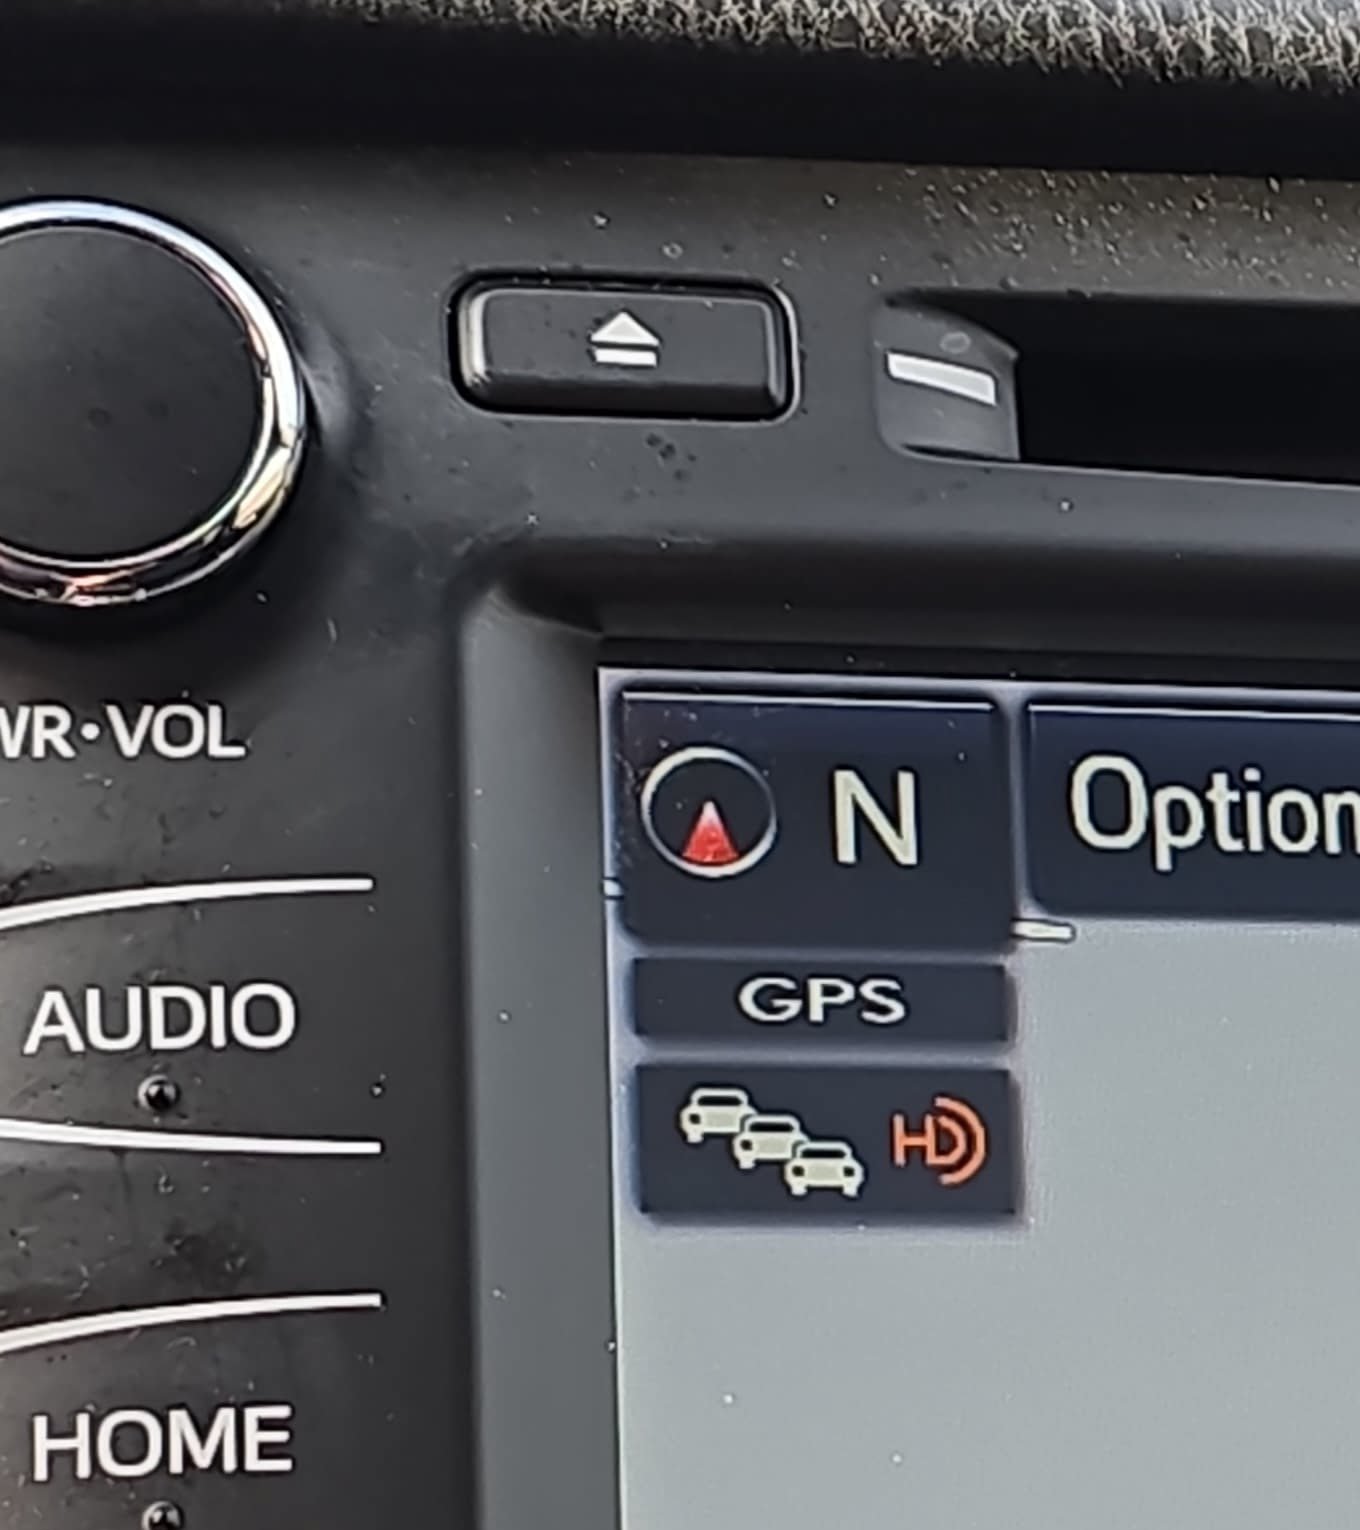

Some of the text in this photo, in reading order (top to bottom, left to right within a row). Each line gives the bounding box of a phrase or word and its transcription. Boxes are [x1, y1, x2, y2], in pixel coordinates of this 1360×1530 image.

[832, 768, 919, 866] N
[22, 983, 297, 1055] AUDIO
[738, 976, 907, 1023] GPS
[32, 1405, 293, 1481] HOME
